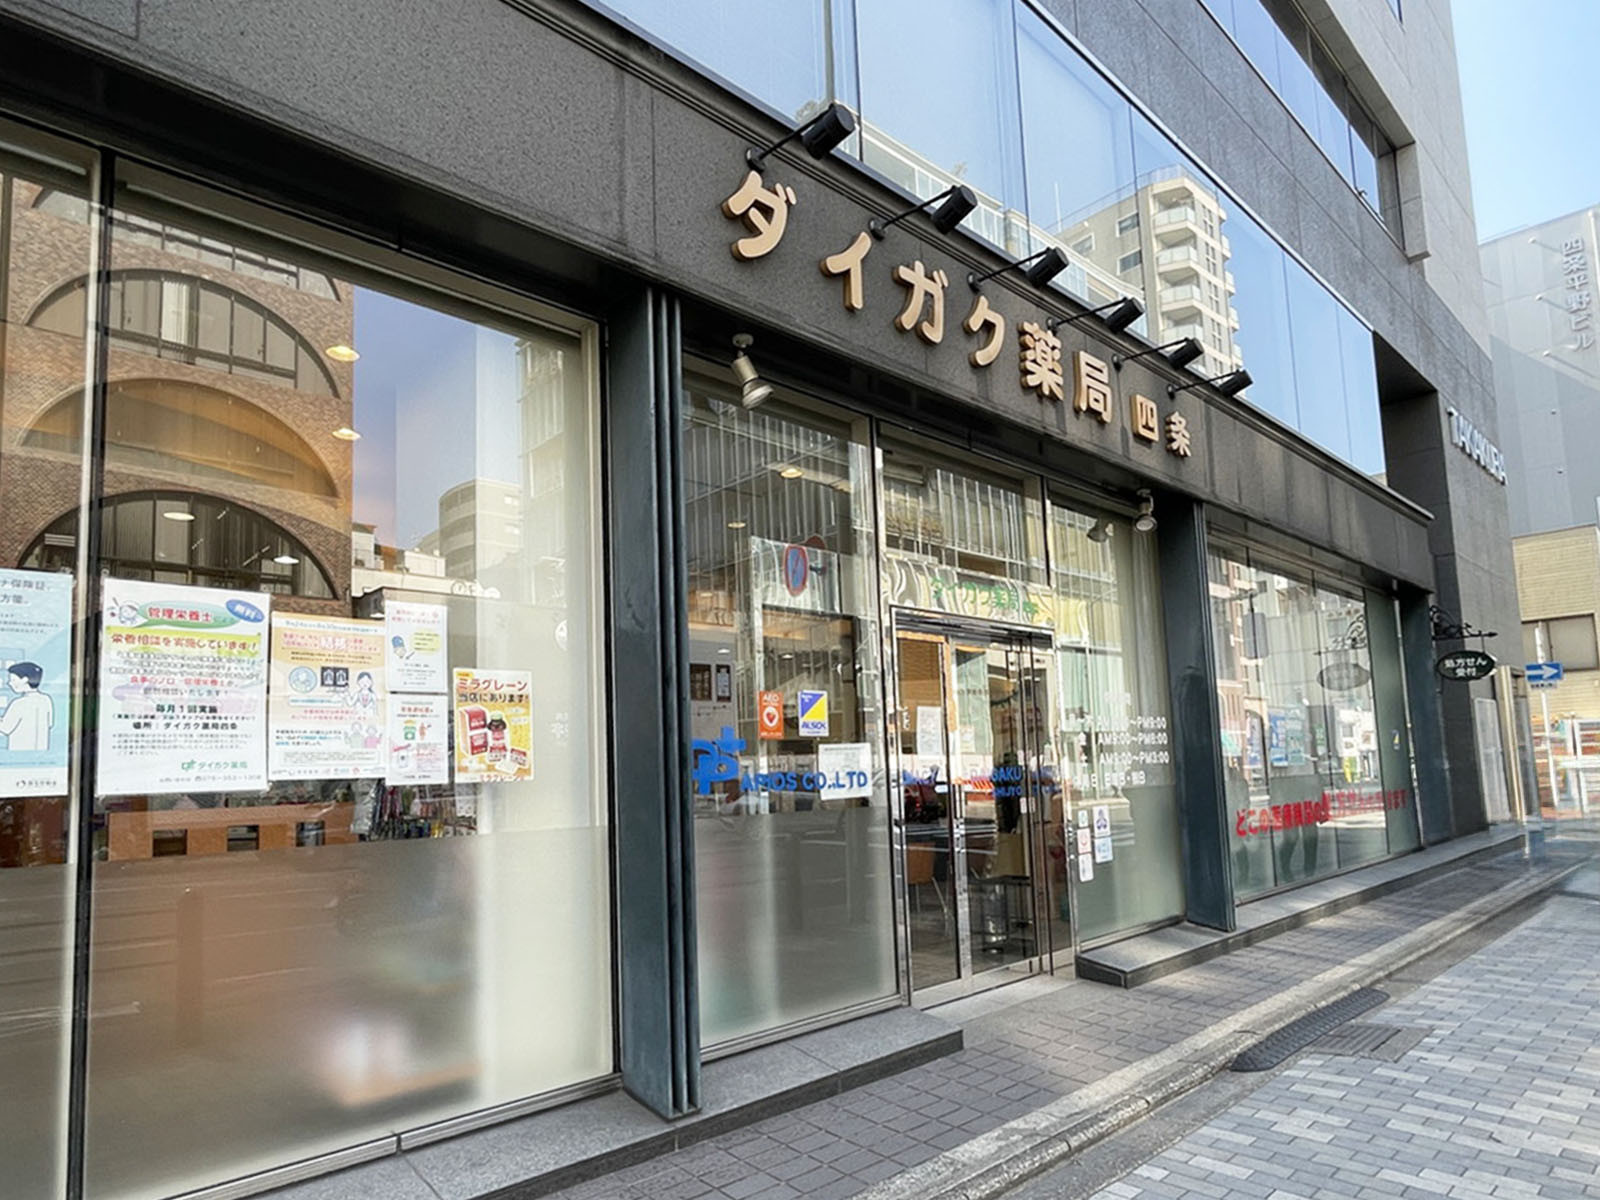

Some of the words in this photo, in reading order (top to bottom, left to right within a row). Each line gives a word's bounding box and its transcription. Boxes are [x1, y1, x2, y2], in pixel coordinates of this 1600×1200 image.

[1455, 667, 1477, 678] 受付
[457, 678, 528, 692] ミラグレーン
